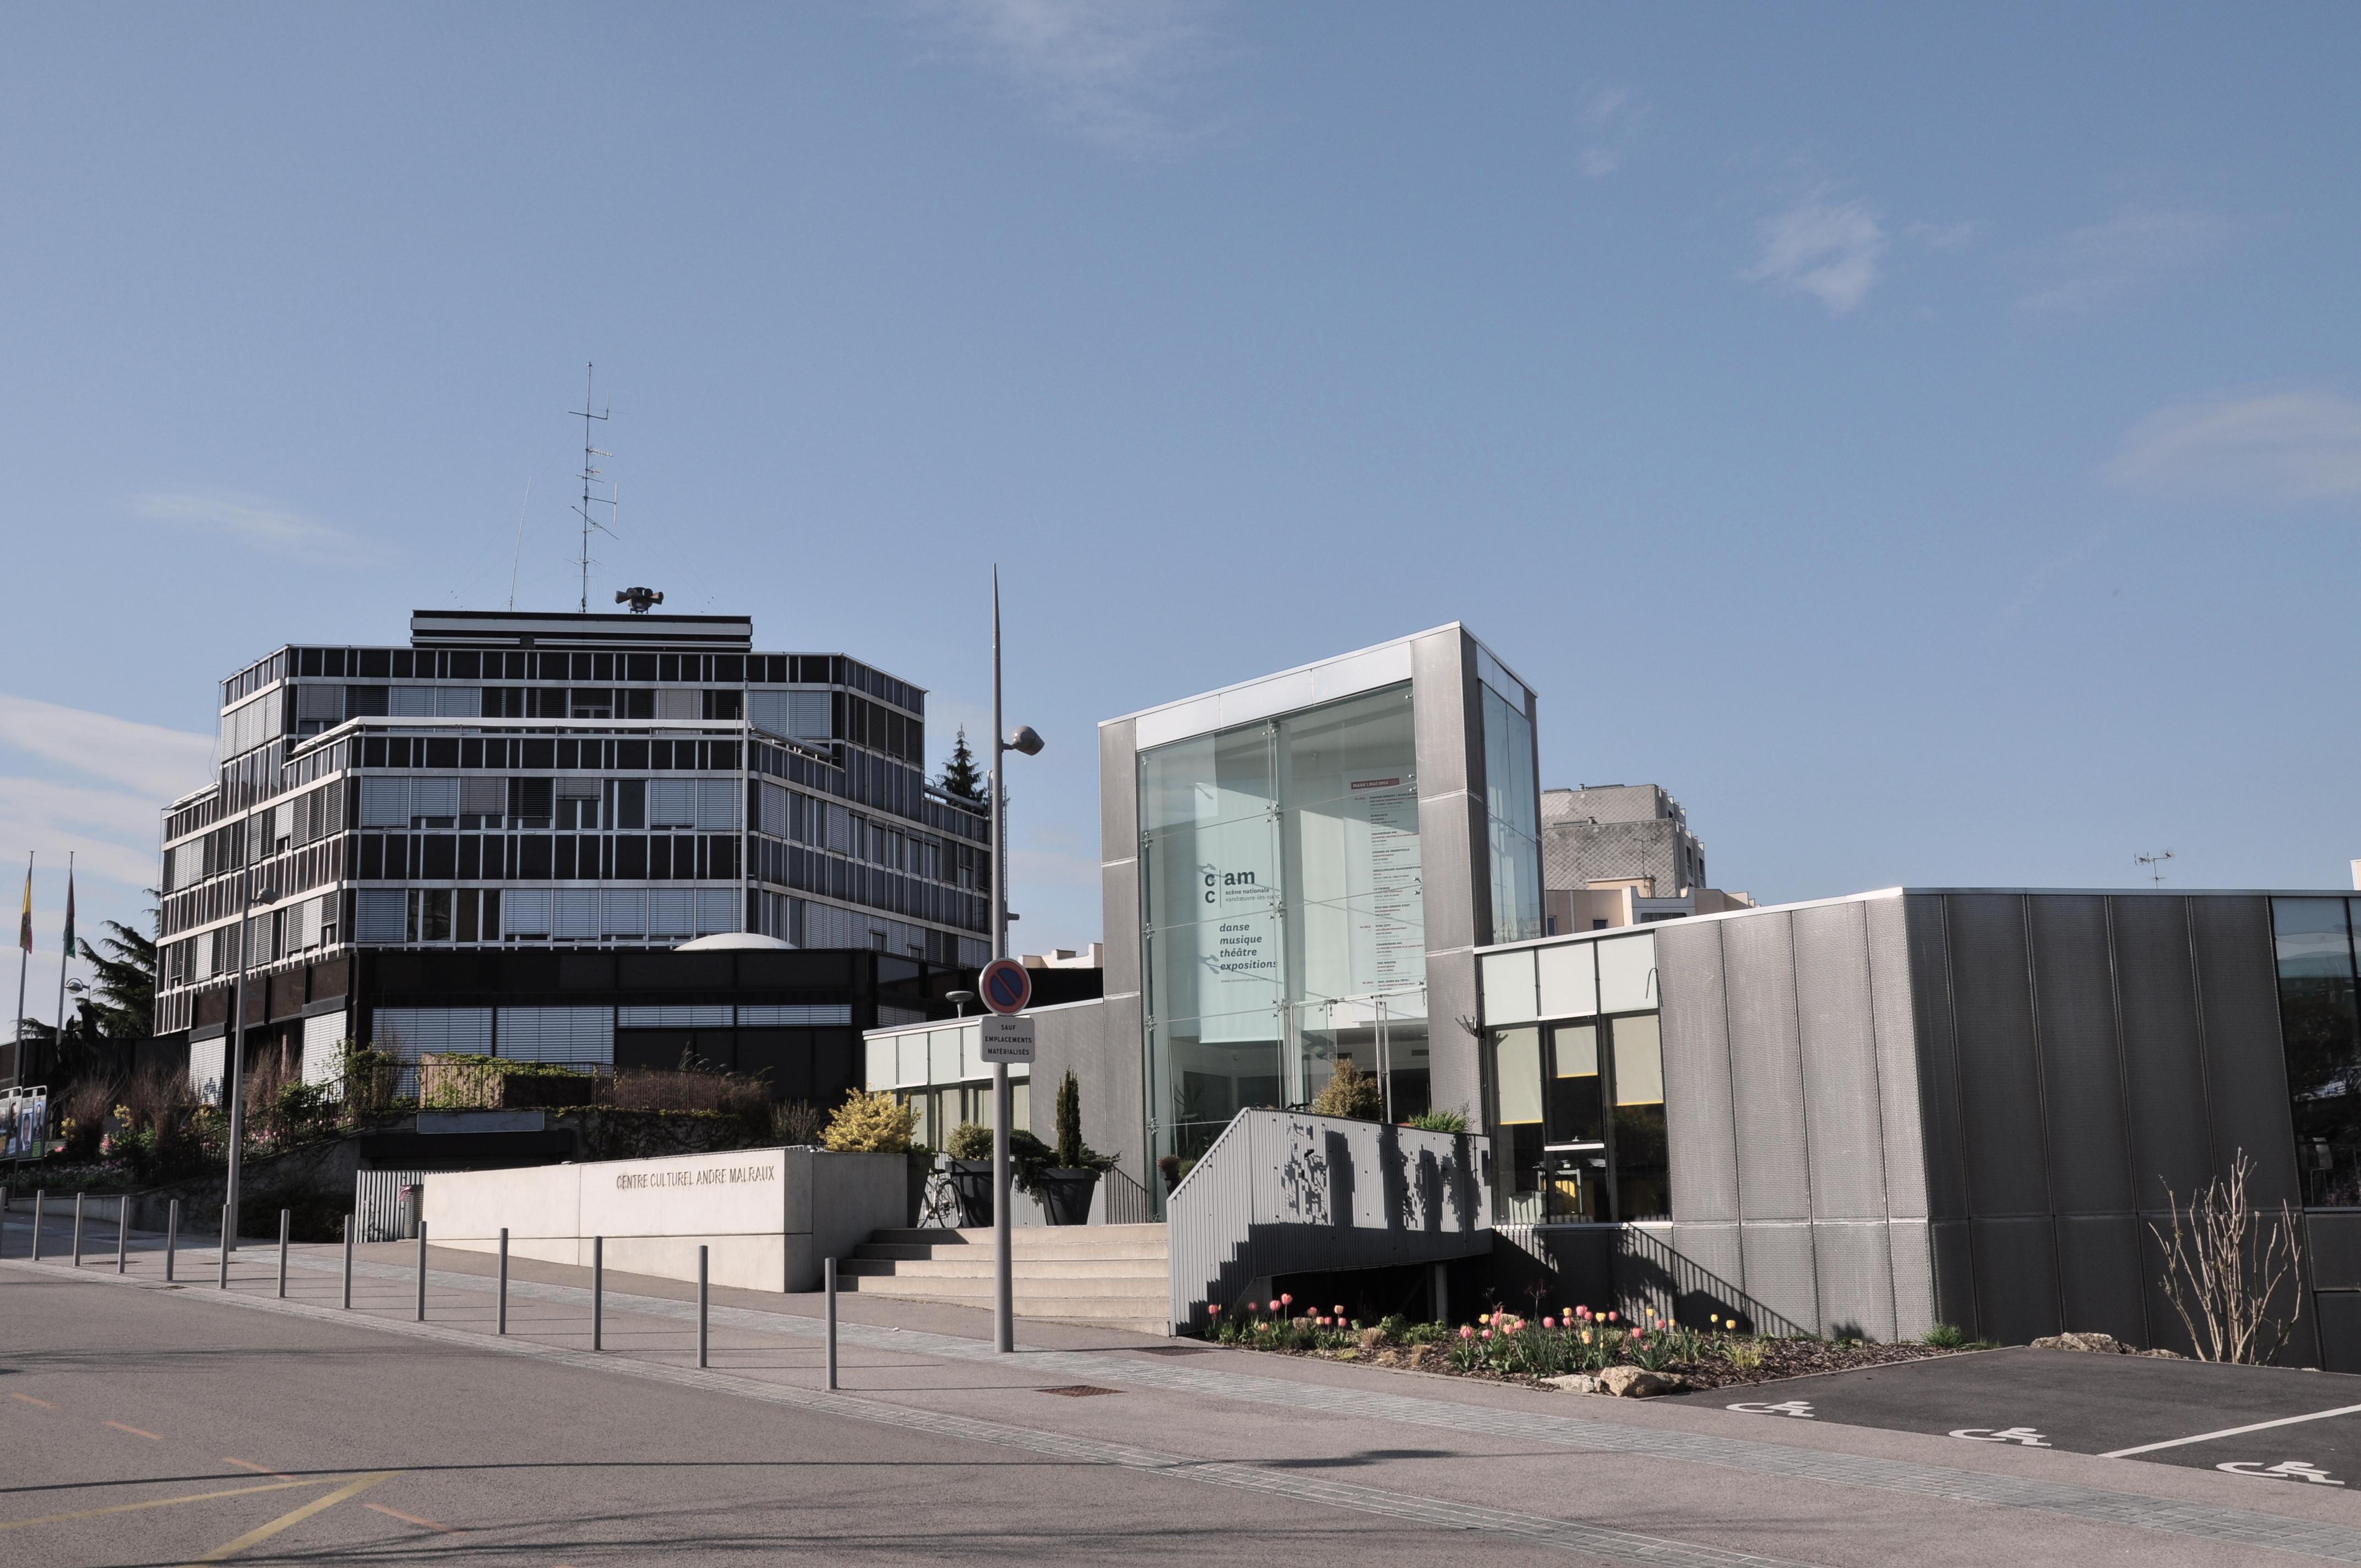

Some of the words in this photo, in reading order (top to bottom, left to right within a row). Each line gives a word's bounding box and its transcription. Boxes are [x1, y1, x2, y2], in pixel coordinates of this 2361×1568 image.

[1220, 923, 1250, 932] danse
[1220, 935, 1262, 946] musique
[1220, 948, 1258, 957] théâtre
[1220, 959, 1278, 972] expositions
[987, 1047, 1030, 1055] MATÉRIALISÉS
[616, 1174, 648, 1190] CENTRE
[650, 1171, 694, 1188] CULTUREL
[696, 1168, 727, 1185] ANDRE
[729, 1165, 775, 1184] MALRAUX
